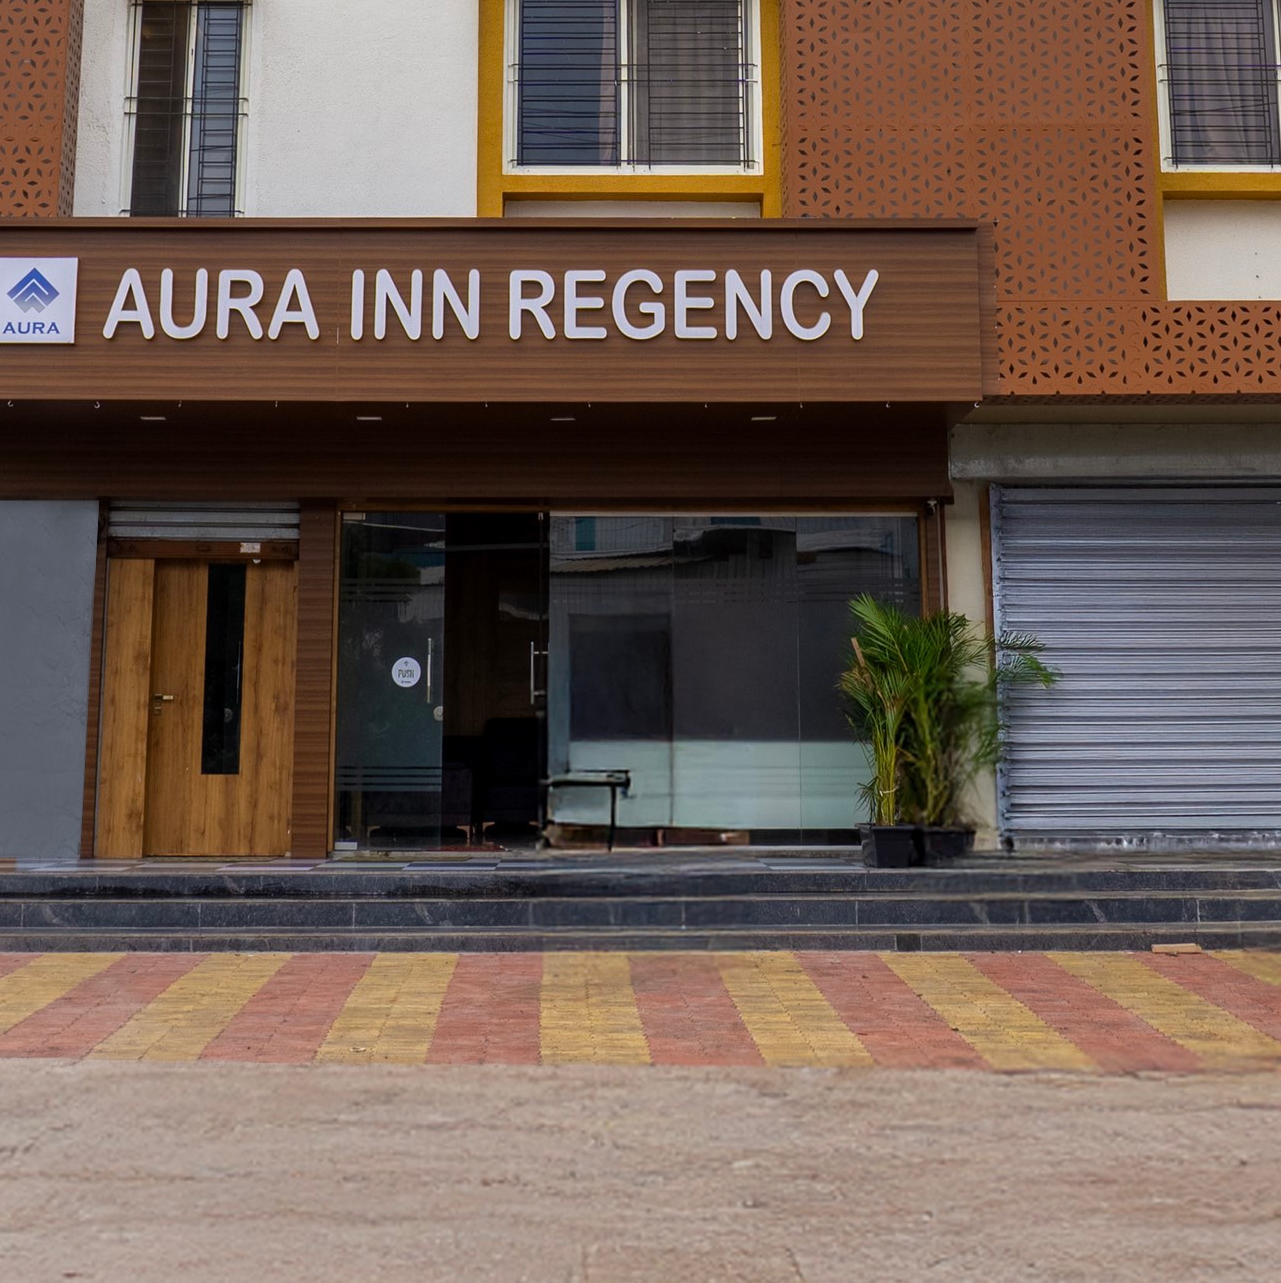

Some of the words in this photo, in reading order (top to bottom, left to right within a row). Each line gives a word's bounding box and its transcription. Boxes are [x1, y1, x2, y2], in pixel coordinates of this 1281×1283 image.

[102, 268, 320, 340] AURA
[350, 268, 480, 340] INN
[509, 268, 879, 340] REGENCY
[2, 321, 60, 334] AURA
[398, 669, 415, 678] PUSH
